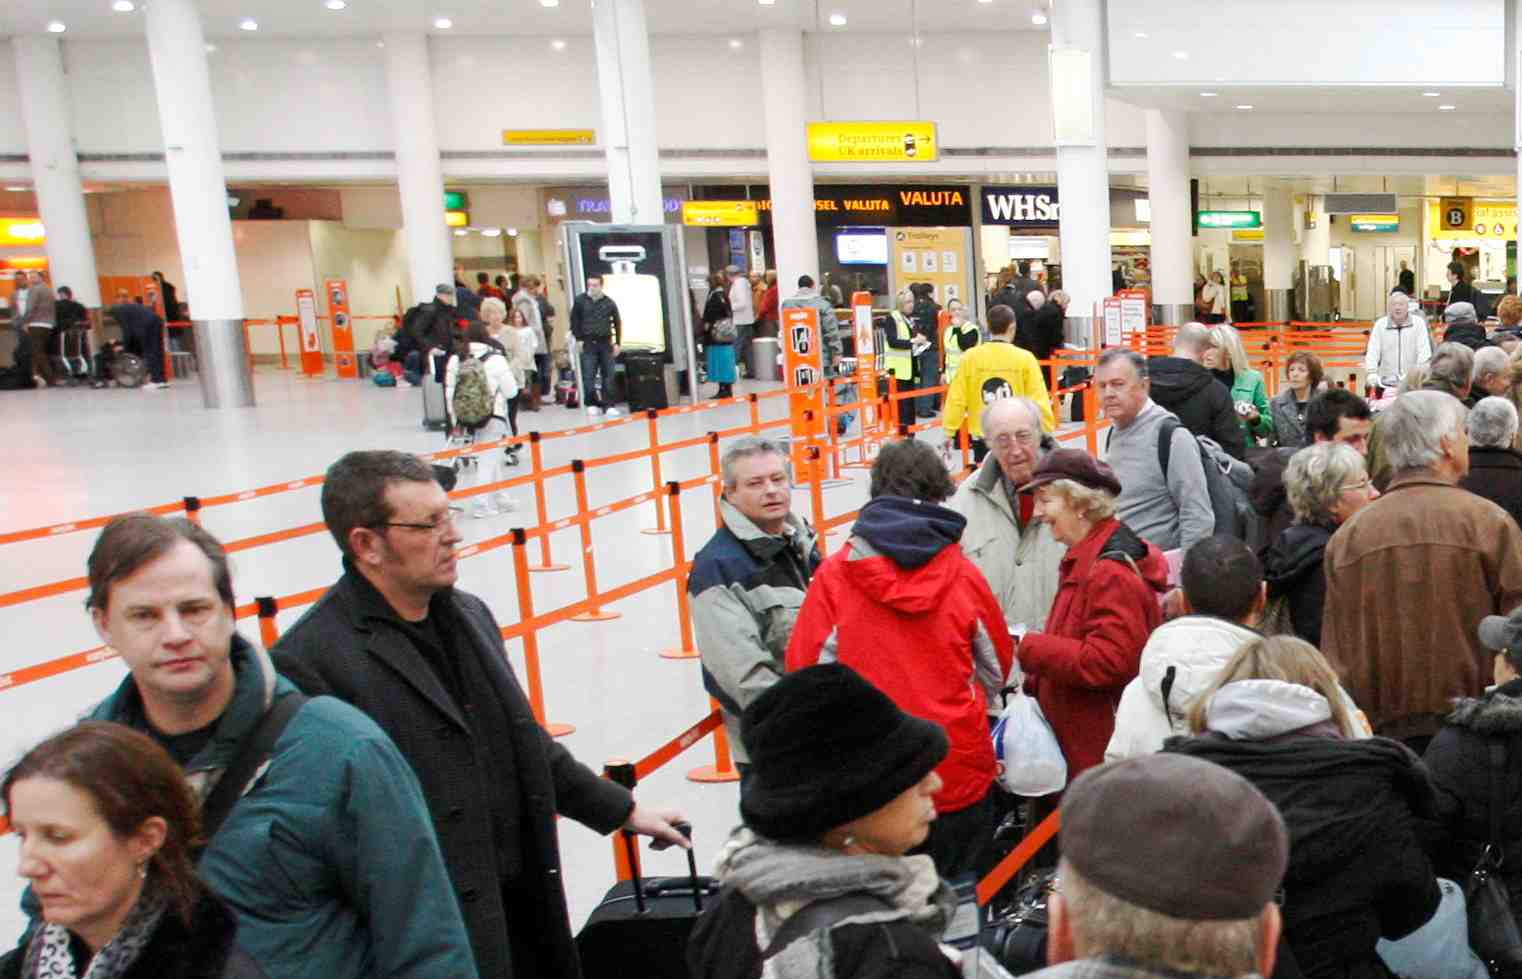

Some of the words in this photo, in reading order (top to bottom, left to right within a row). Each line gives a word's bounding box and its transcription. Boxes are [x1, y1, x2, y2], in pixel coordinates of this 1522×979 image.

[838, 134, 902, 145] Departures
[843, 199, 890, 211] VALUTA
[900, 190, 964, 207] VALUTA
[1450, 210, 1463, 225] B
